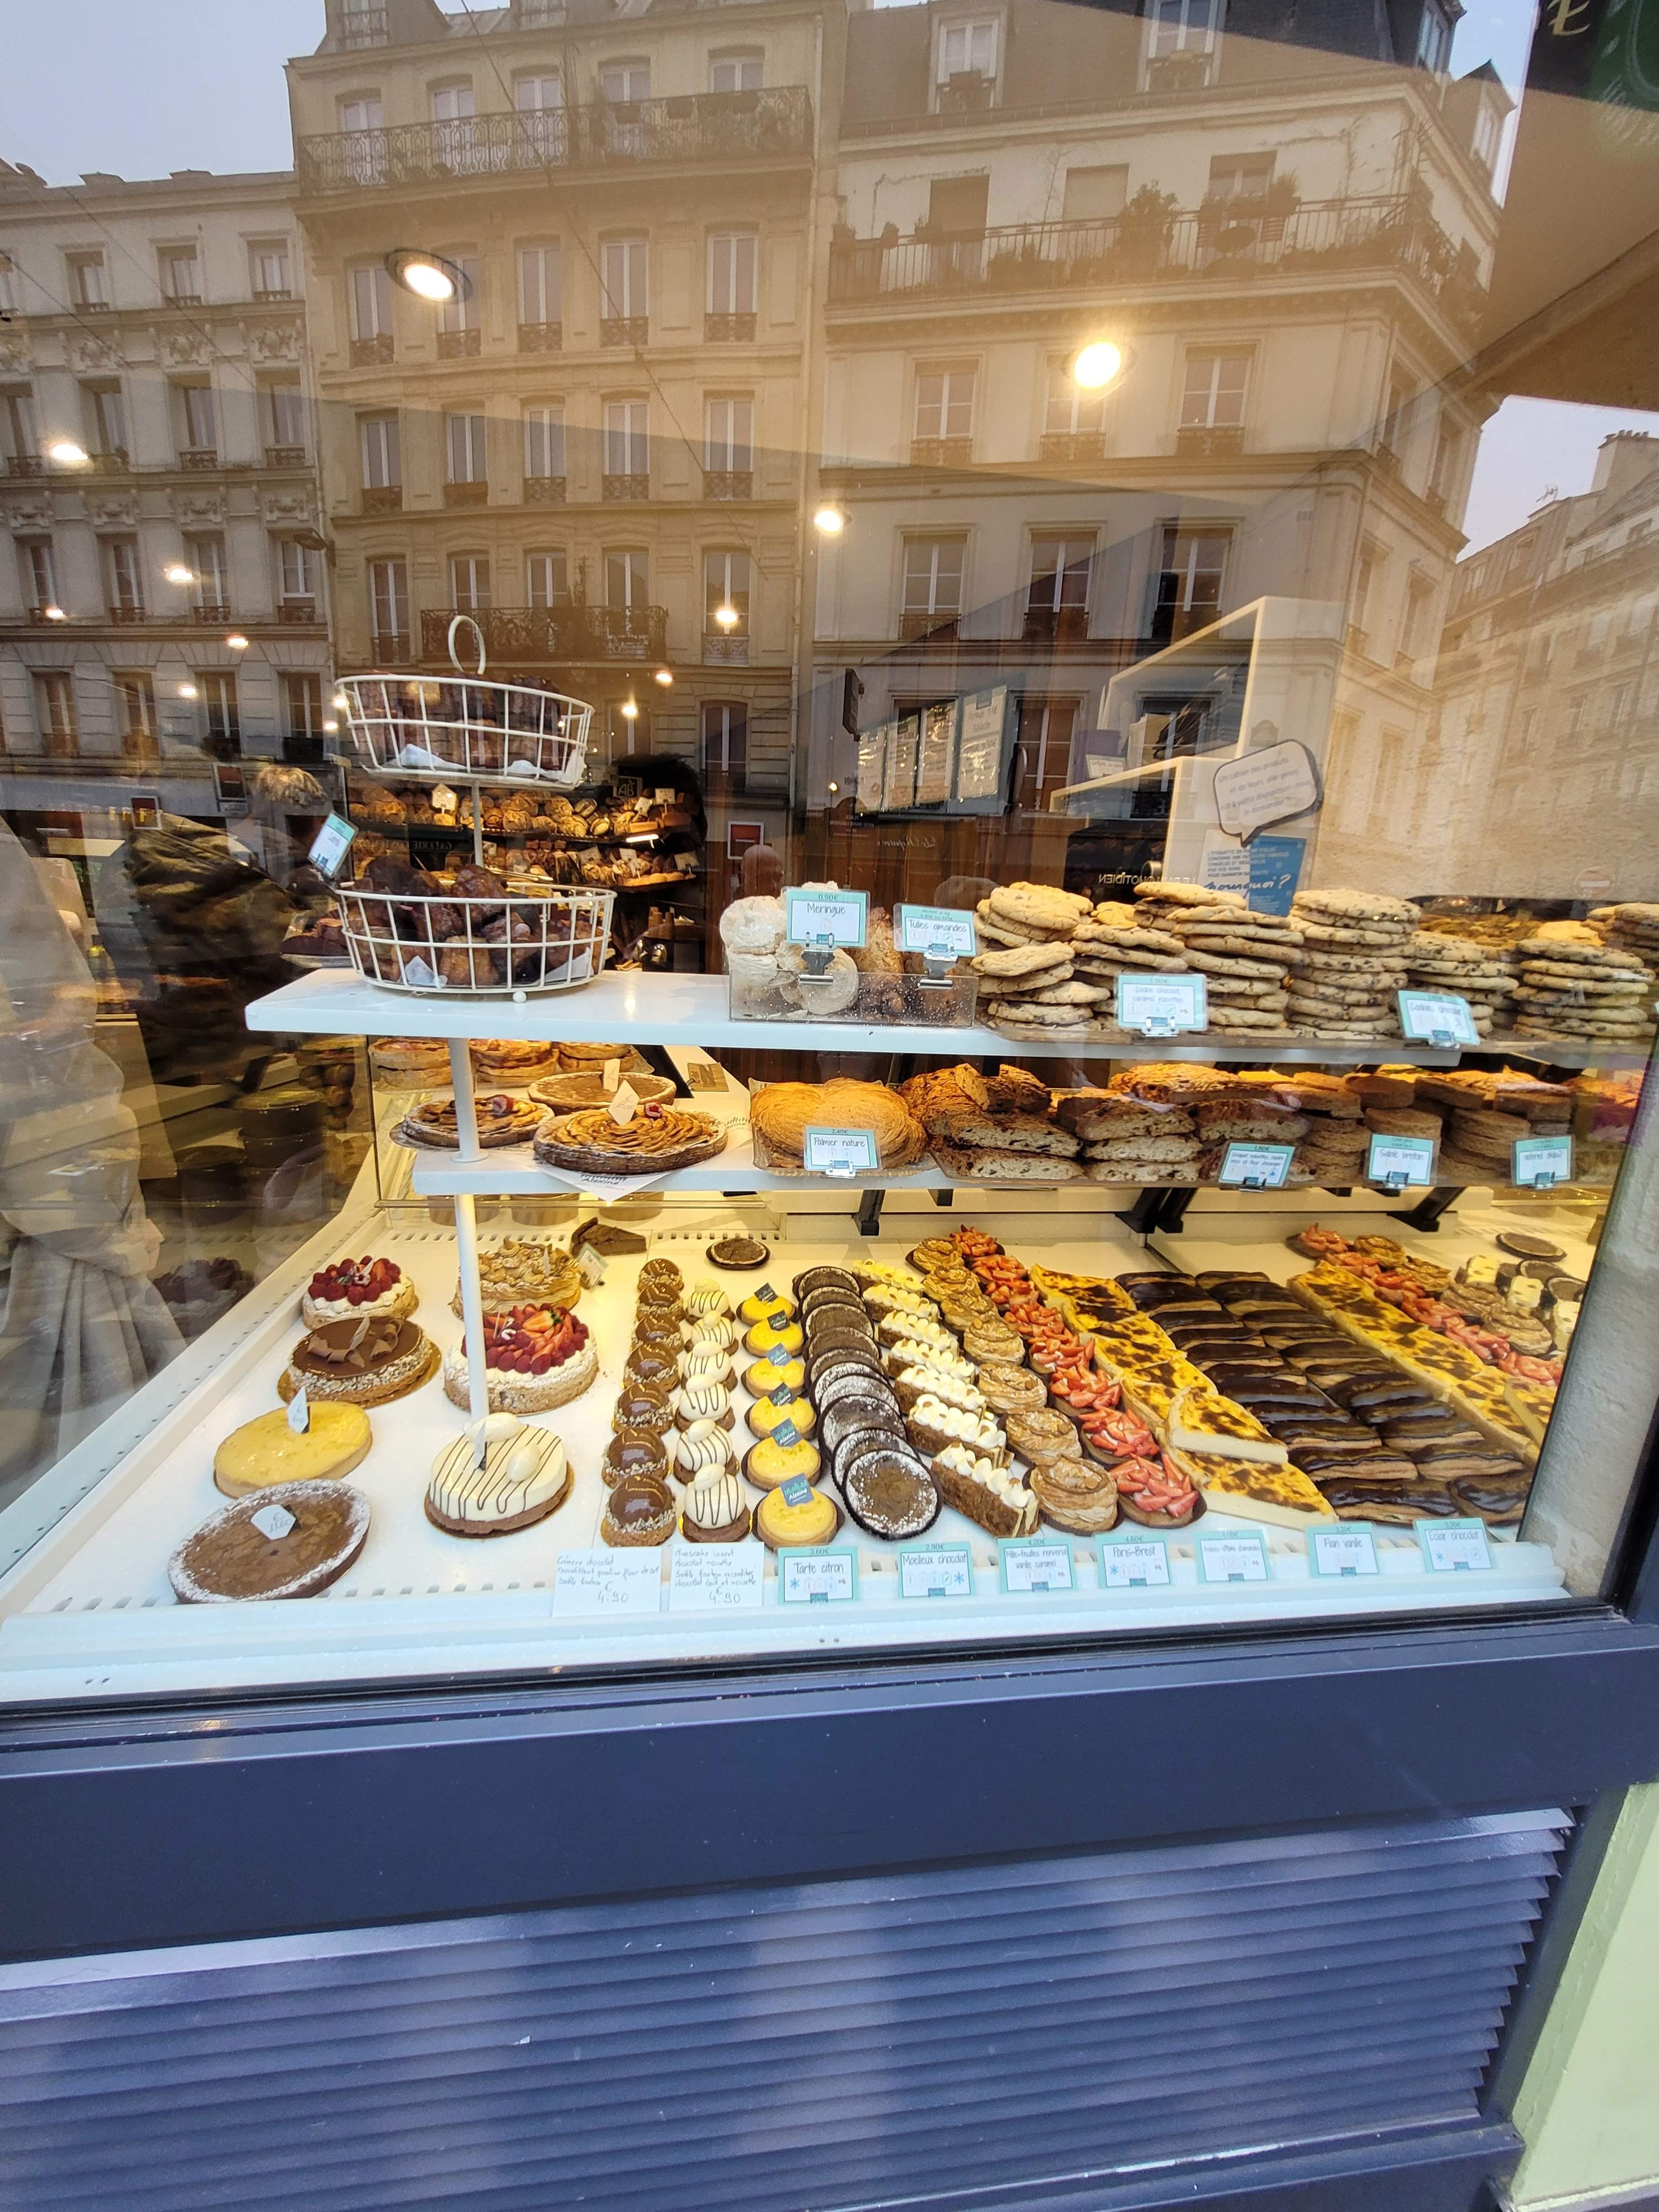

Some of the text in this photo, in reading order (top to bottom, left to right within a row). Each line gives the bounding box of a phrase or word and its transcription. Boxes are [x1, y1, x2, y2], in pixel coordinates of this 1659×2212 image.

[1203, 875, 1276, 899] pourquoi
[807, 902, 846, 917] Meringue
[907, 919, 968, 933] Tuiles amandes
[814, 1138, 865, 1147] Palmier nature
[1402, 1151, 1424, 1160] breton
[1452, 1530, 1479, 1540] chocolat
[1324, 1537, 1363, 1548] Flan vanille
[1113, 1545, 1156, 1557] Paris-Brest
[586, 1554, 614, 1566] chocolat
[902, 1553, 966, 1566] Moelleux chocolat
[1015, 1559, 1056, 1569] vanille caramel
[794, 1562, 844, 1574] Tarte citron
